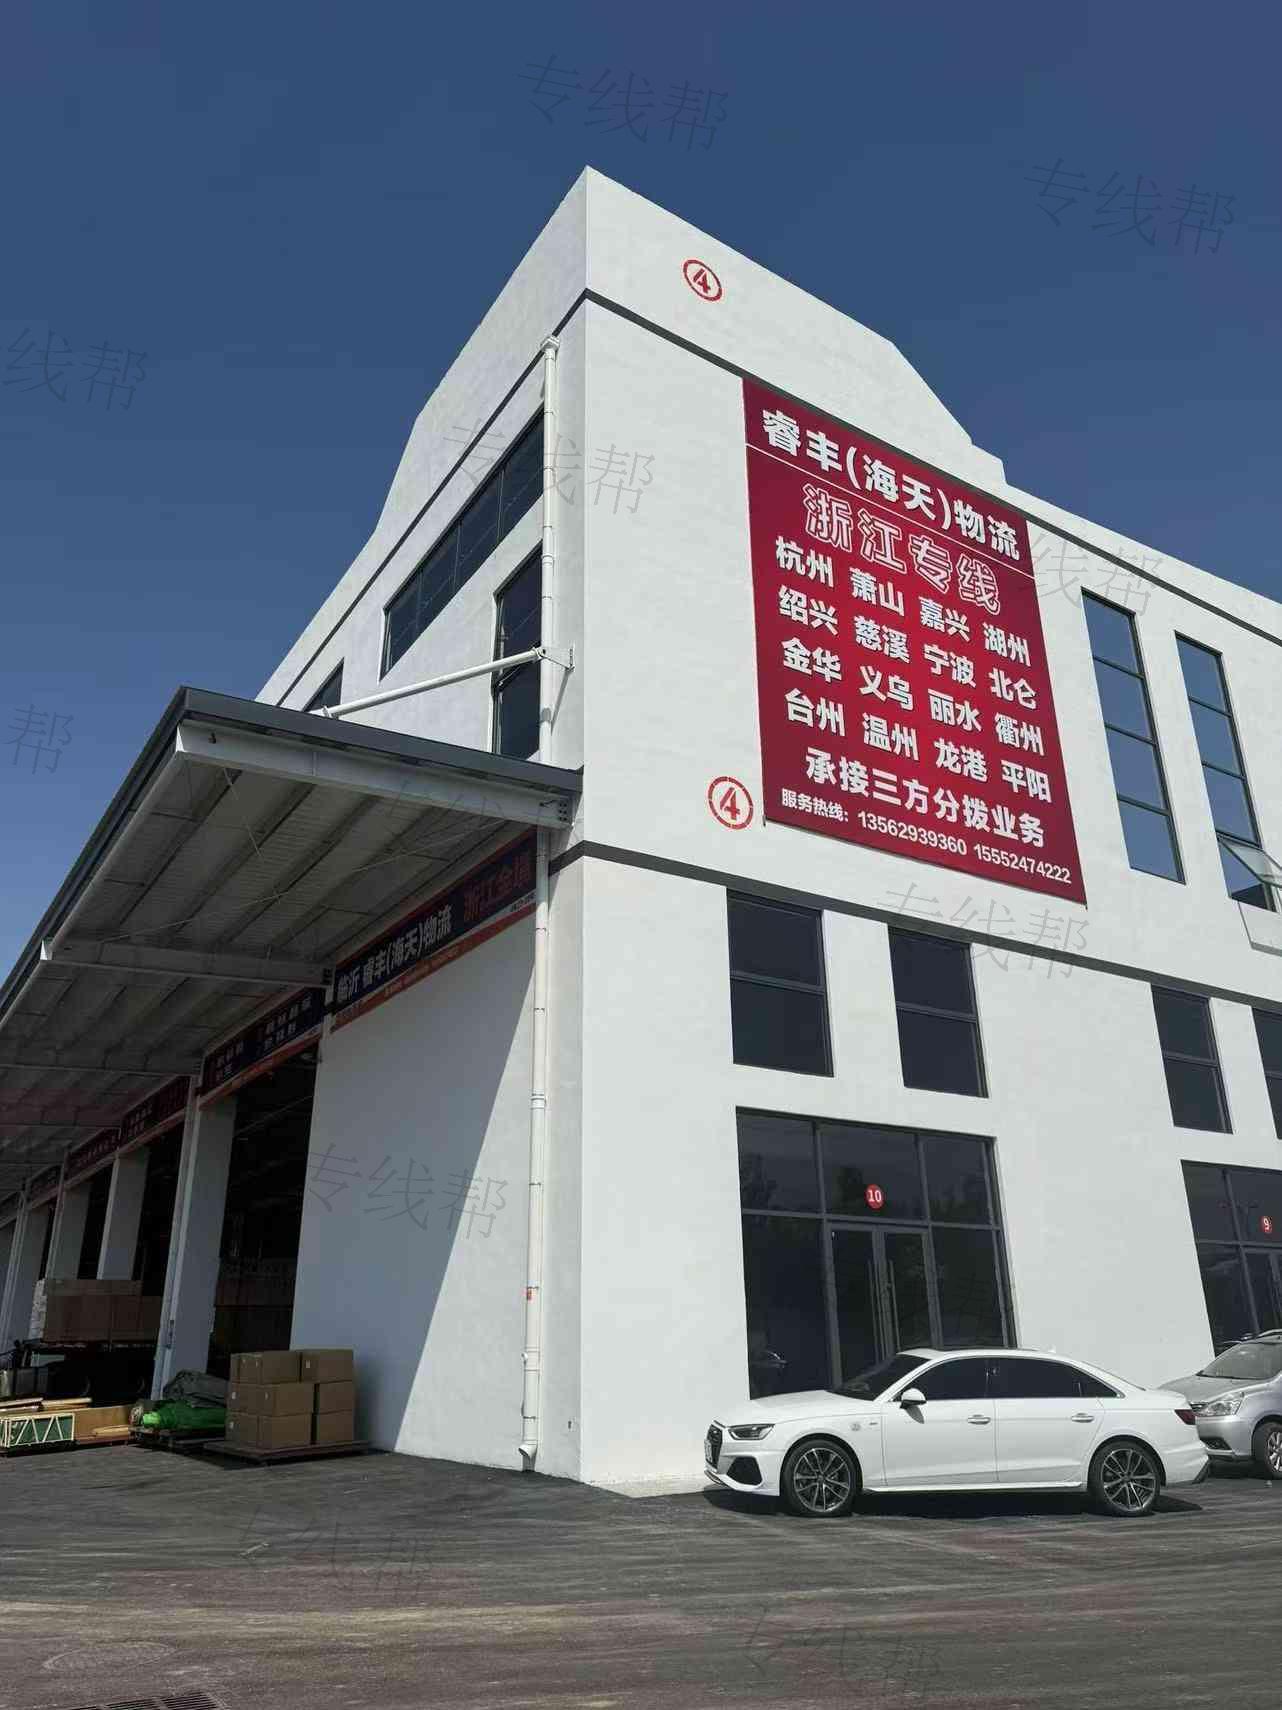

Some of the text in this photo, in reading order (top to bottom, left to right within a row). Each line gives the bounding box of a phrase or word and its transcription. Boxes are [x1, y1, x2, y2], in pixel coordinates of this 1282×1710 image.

[762, 409, 1020, 561] 睿丰(海天)物流
[775, 535, 1031, 667] 杭州 萧山 嘉兴 湖州
[802, 484, 1000, 615] 浙江专线
[778, 584, 1037, 710] 绍兴 慈溪 宁波 北仑
[781, 637, 1045, 756] 金华 义乌 丽水 衢州
[784, 687, 1052, 803] 台州 温州 龙港 平阳
[806, 747, 1044, 849] 承接三方分拨业务
[857, 810, 967, 856] 13562939360
[973, 843, 1072, 884] 15552474222
[868, 1190, 882, 1203] 10
